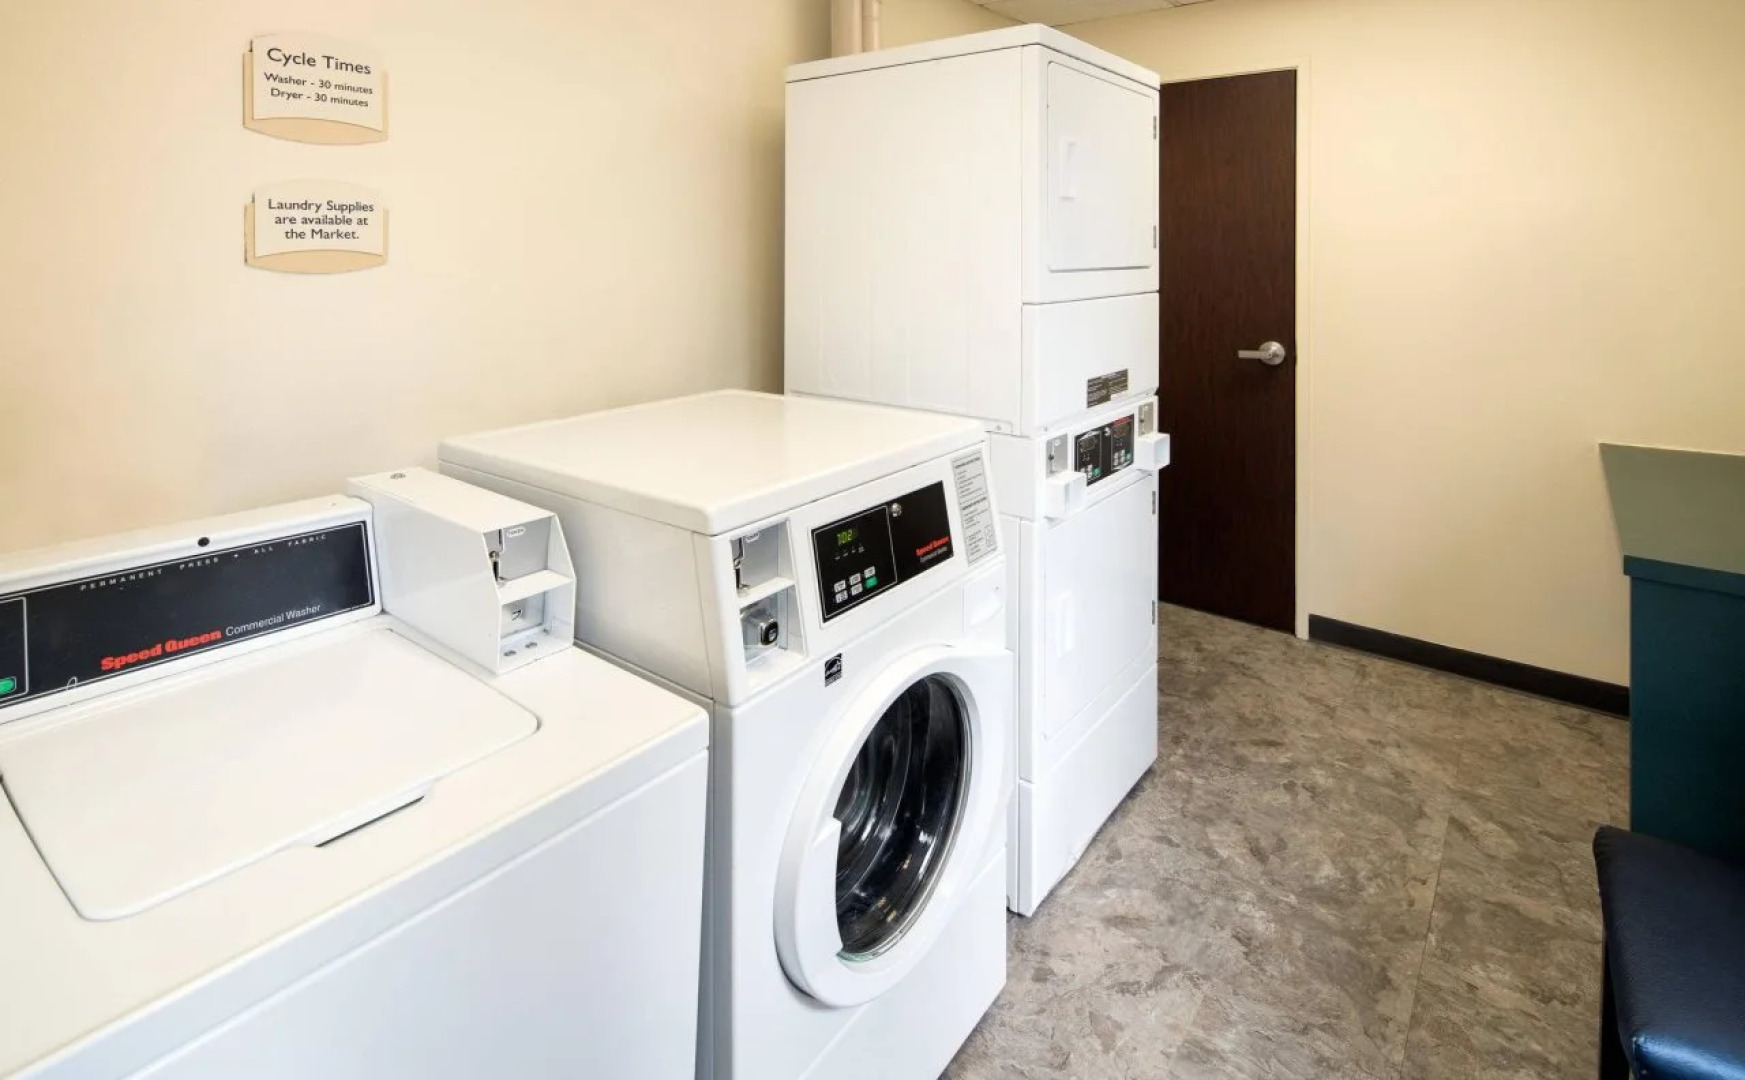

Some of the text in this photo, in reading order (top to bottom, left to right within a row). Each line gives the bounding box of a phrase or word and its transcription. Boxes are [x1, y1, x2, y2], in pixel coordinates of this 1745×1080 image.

[266, 47, 372, 75] Cycle Times
[264, 72, 308, 86] Washer
[318, 79, 331, 90] 30
[334, 83, 373, 95] minutes
[270, 88, 303, 100] Dryer
[314, 93, 327, 102] 30
[330, 96, 369, 107] minutes
[268, 199, 374, 214] Laundry Supplies
[274, 215, 369, 226] are available at
[284, 229, 360, 240] the Market.
[80, 568, 164, 591] PERMANENT
[179, 556, 219, 571] PRESS
[253, 545, 274, 555] ALL
[100, 603, 322, 672] Speed Queen Commercial Washer
